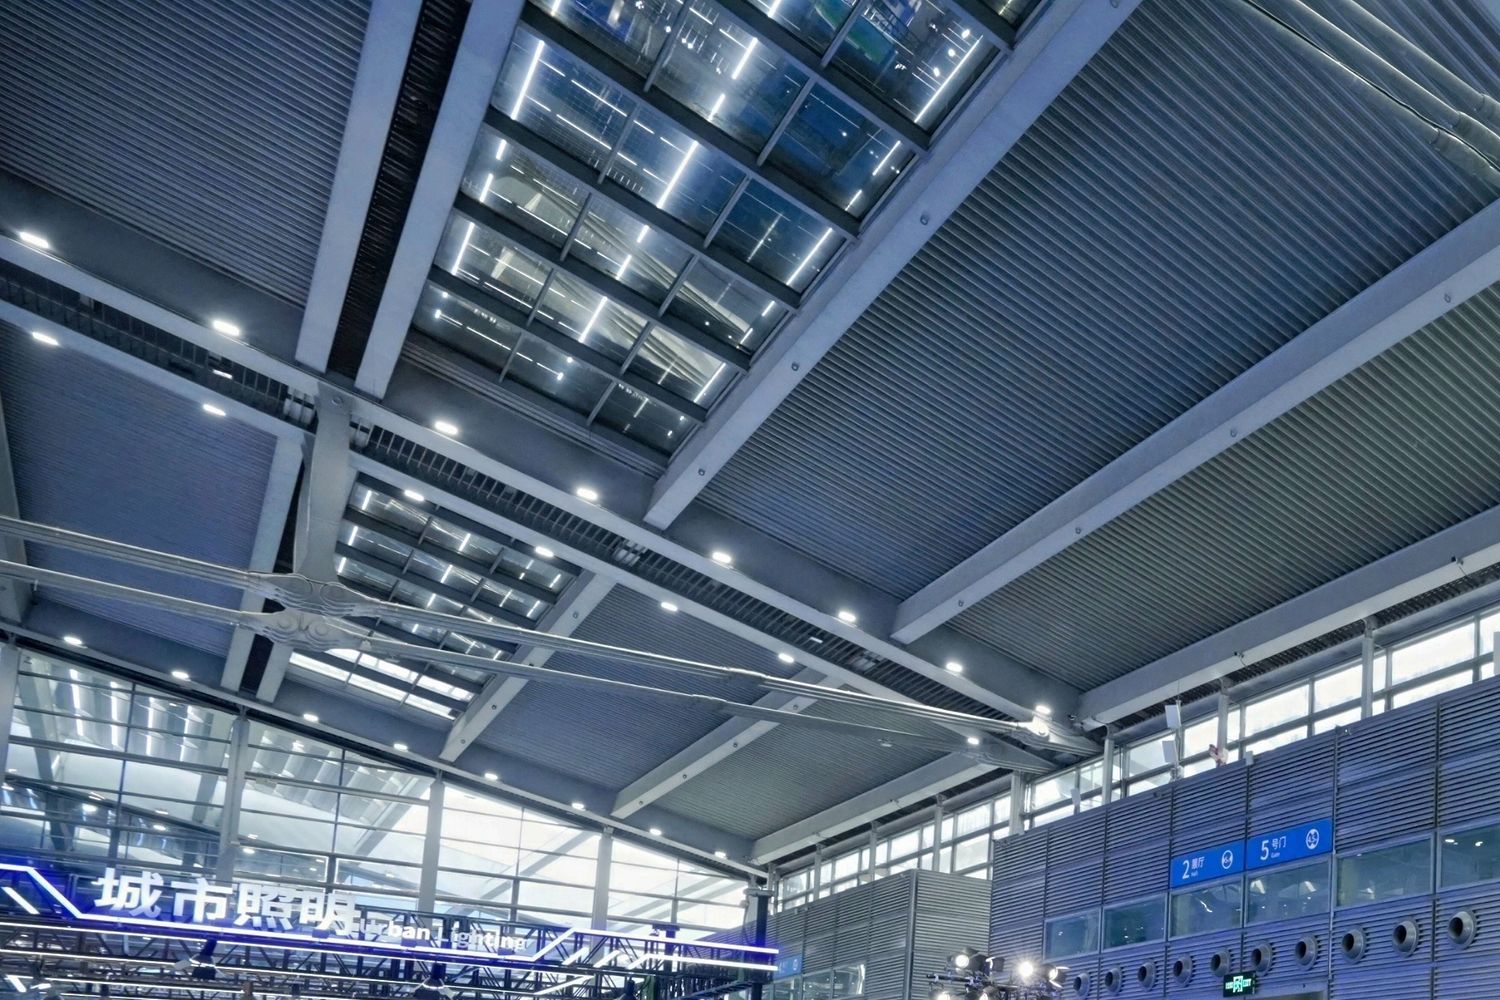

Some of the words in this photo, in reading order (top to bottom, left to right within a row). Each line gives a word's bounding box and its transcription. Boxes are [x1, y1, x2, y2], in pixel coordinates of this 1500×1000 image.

[1260, 840, 1269, 861] 5
[1272, 836, 1287, 850] 号门
[1182, 860, 1190, 879] 2
[94, 867, 359, 937] 城市照明
